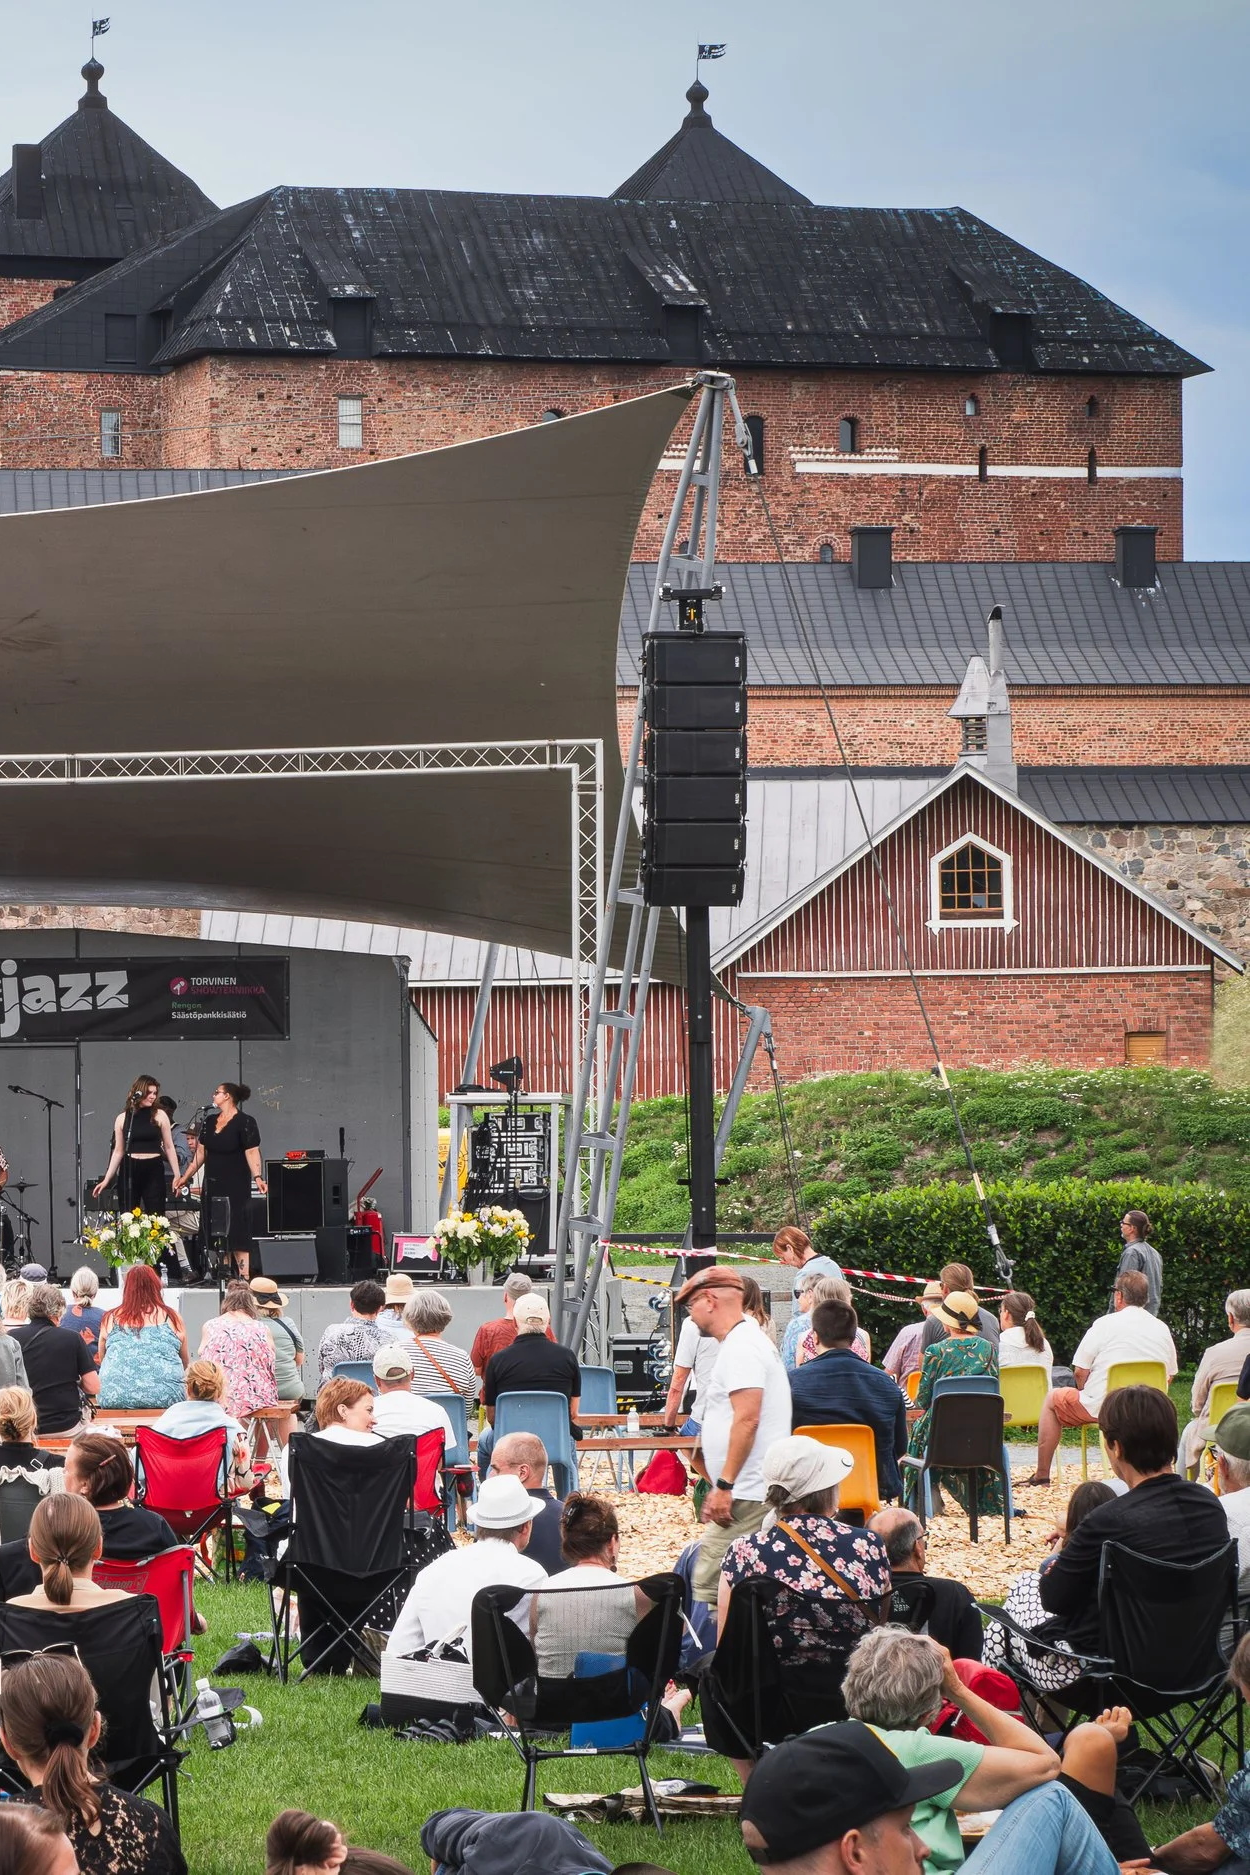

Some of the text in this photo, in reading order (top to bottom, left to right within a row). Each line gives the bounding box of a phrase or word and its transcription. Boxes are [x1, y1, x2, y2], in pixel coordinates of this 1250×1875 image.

[190, 977, 237, 986] TORVINEN
[171, 1001, 202, 1010] Rengon
[171, 1011, 247, 1020] Säästöpankkisäätiö
